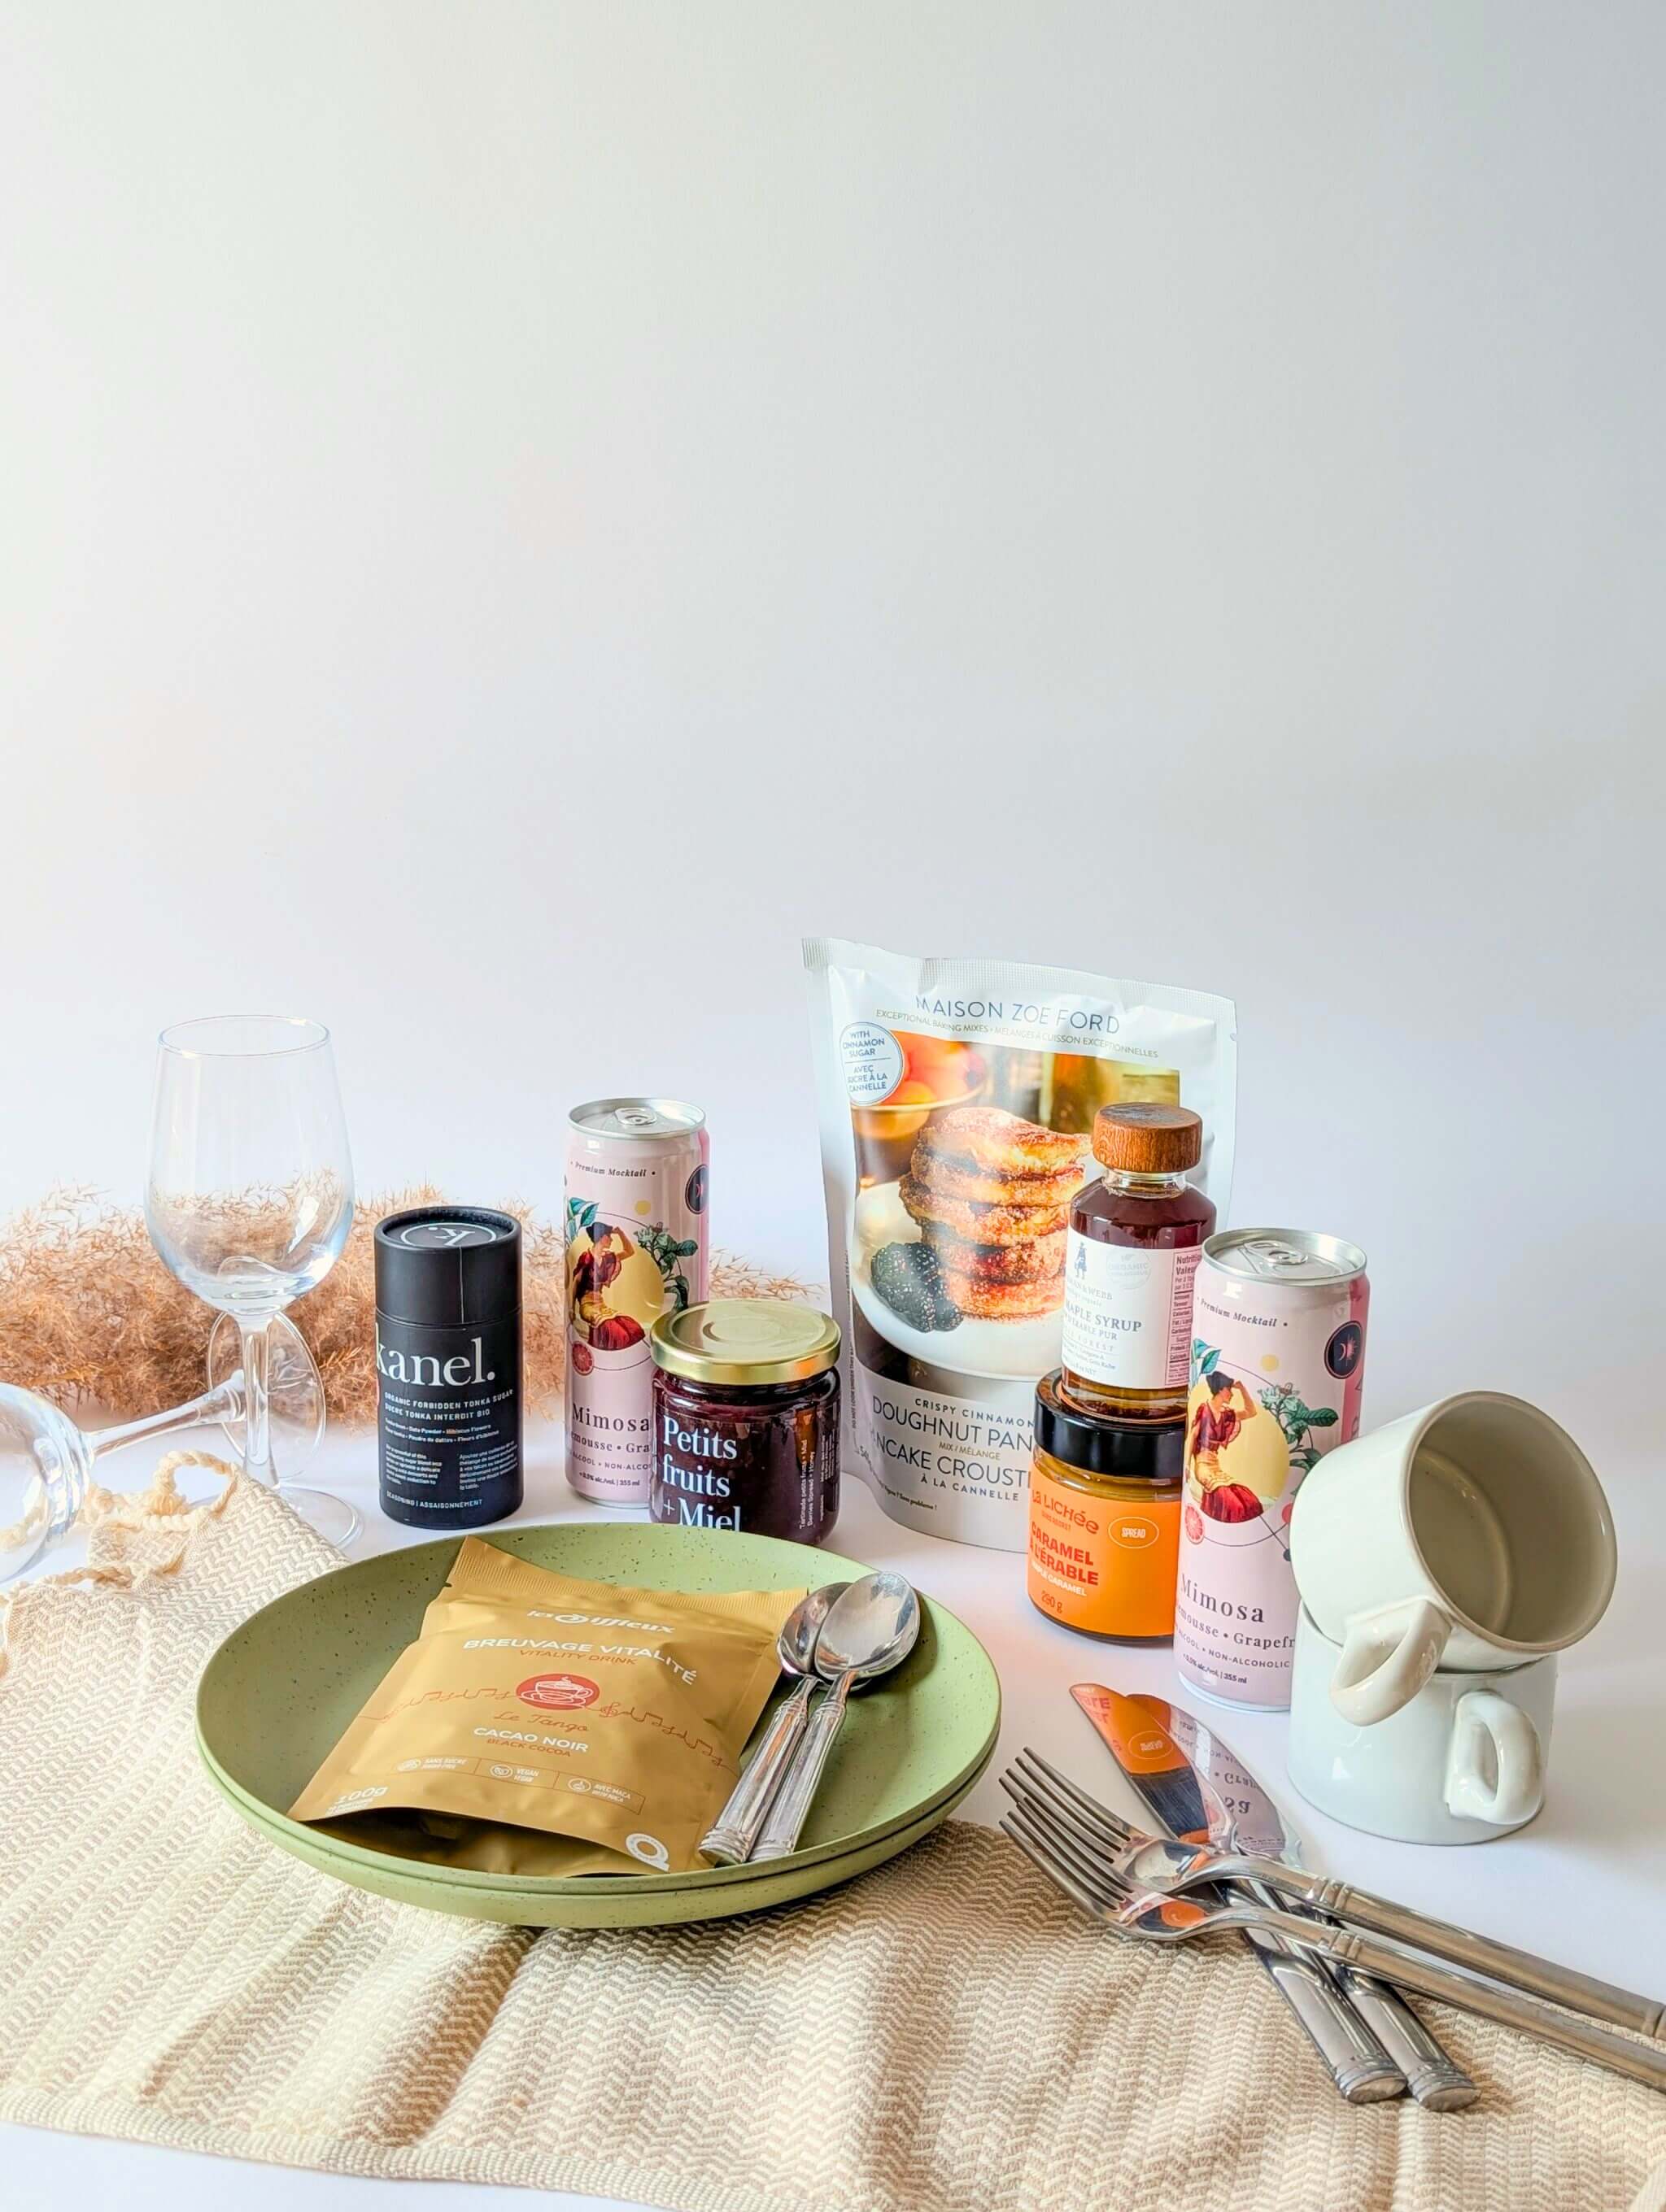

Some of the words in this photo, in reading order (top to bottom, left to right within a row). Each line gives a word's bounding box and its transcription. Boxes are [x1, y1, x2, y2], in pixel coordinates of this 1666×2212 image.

[915, 995, 1003, 1019] MAISON
[1056, 1009, 1120, 1034] FORD
[849, 1029, 870, 1039] WITH
[875, 1008, 931, 1025] EXCEPTIONAL
[962, 1025, 989, 1034] MIXES
[1042, 1033, 1081, 1045] CUISSON
[1083, 1037, 1159, 1058] EXCEPTIONNELLES
[848, 1047, 875, 1058] SUGAR
[853, 1064, 874, 1073] AVEC
[876, 1073, 888, 1081] LA
[574, 1161, 605, 1175] Premium
[608, 1169, 648, 1178] Mocktail
[1095, 1313, 1142, 1333] SYRUP
[1200, 1300, 1230, 1318] Premium
[1232, 1311, 1277, 1327] Mocktail
[1099, 1329, 1118, 1341] PUR
[375, 1322, 495, 1387] kanel.
[385, 1391, 411, 1406] ORGANIC
[412, 1400, 461, 1409] FORBIDDEN
[464, 1397, 491, 1408] TONKA
[492, 1389, 513, 1403] SUGAR
[385, 1403, 403, 1416] SUCRE
[405, 1411, 431, 1421] TONKA
[434, 1411, 473, 1421] INTERDIT
[477, 1409, 491, 1417] BIO
[572, 1403, 650, 1432] Mimosa
[872, 1395, 982, 1444] DOUGHNUT
[988, 1428, 1032, 1452] PAN
[915, 1398, 956, 1415] CRISPY
[962, 1409, 1035, 1428] CINNAMON
[663, 1415, 737, 1460] Petits
[939, 1441, 953, 1452] MIX
[959, 1444, 1001, 1461] MÉLANGE
[662, 1453, 731, 1498] fruits
[920, 1473, 927, 1484] À
[933, 1478, 947, 1489] LA
[952, 1483, 1019, 1501] CANNELLE
[420, 1499, 482, 1509] ASSAISONNEMENT
[663, 1499, 675, 1517] +
[678, 1497, 741, 1532] Miel
[1031, 1520, 1094, 1566] CARAMEL
[1121, 1526, 1146, 1539] SPREAD
[1035, 1544, 1099, 1586] L'ÉRABLE
[1047, 1573, 1088, 1597] CARAMEL
[1180, 1572, 1265, 1624] Mimosa
[463, 1638, 594, 1652] BREUVAGE
[600, 1644, 698, 1686] VITALITÉ
[520, 1649, 587, 1660] VITALITY
[588, 1654, 639, 1666] DRINK
[1208, 1648, 1290, 1669] NON-ALCOHOLIC
[1223, 1673, 1237, 1682] 355
[493, 1711, 521, 1722] Le
[527, 1713, 589, 1733] Tango
[473, 1727, 539, 1743] CACAO
[542, 1735, 589, 1753] NOIR
[486, 1738, 528, 1749] BLACK
[528, 1744, 571, 1757] COCOA
